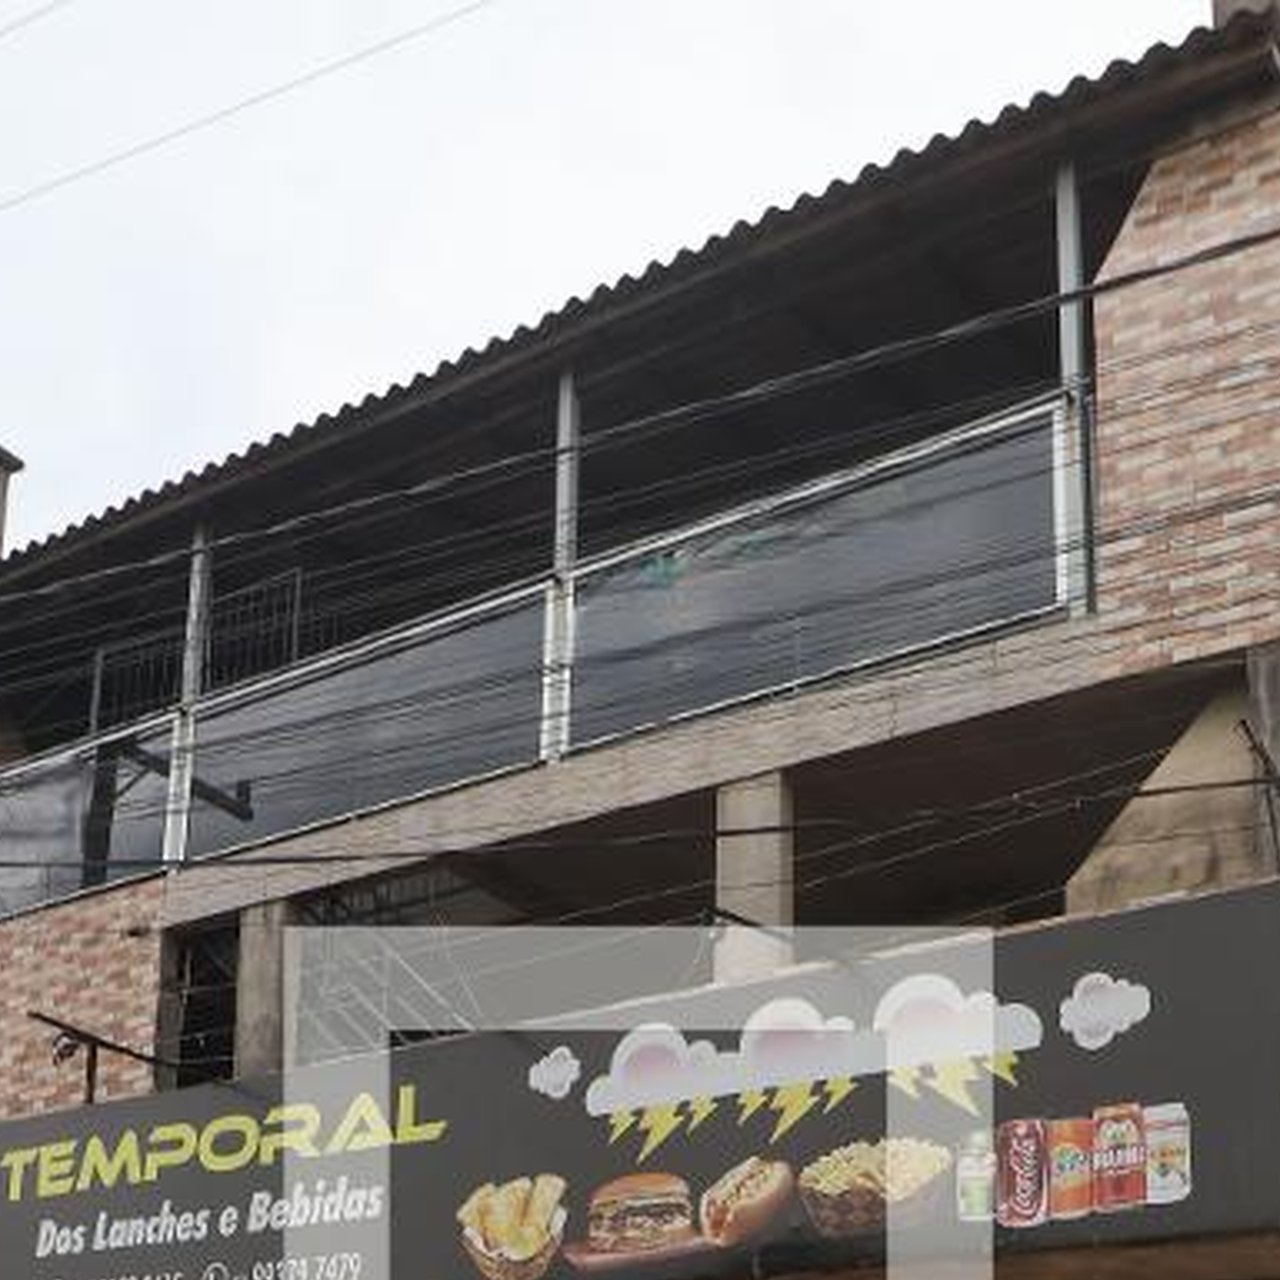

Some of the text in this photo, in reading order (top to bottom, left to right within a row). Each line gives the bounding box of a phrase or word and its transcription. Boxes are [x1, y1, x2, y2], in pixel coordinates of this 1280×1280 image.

[0, 1085, 448, 1202] TEMPORAL
[35, 1173, 384, 1259] Dos Lanches e Bebidas
